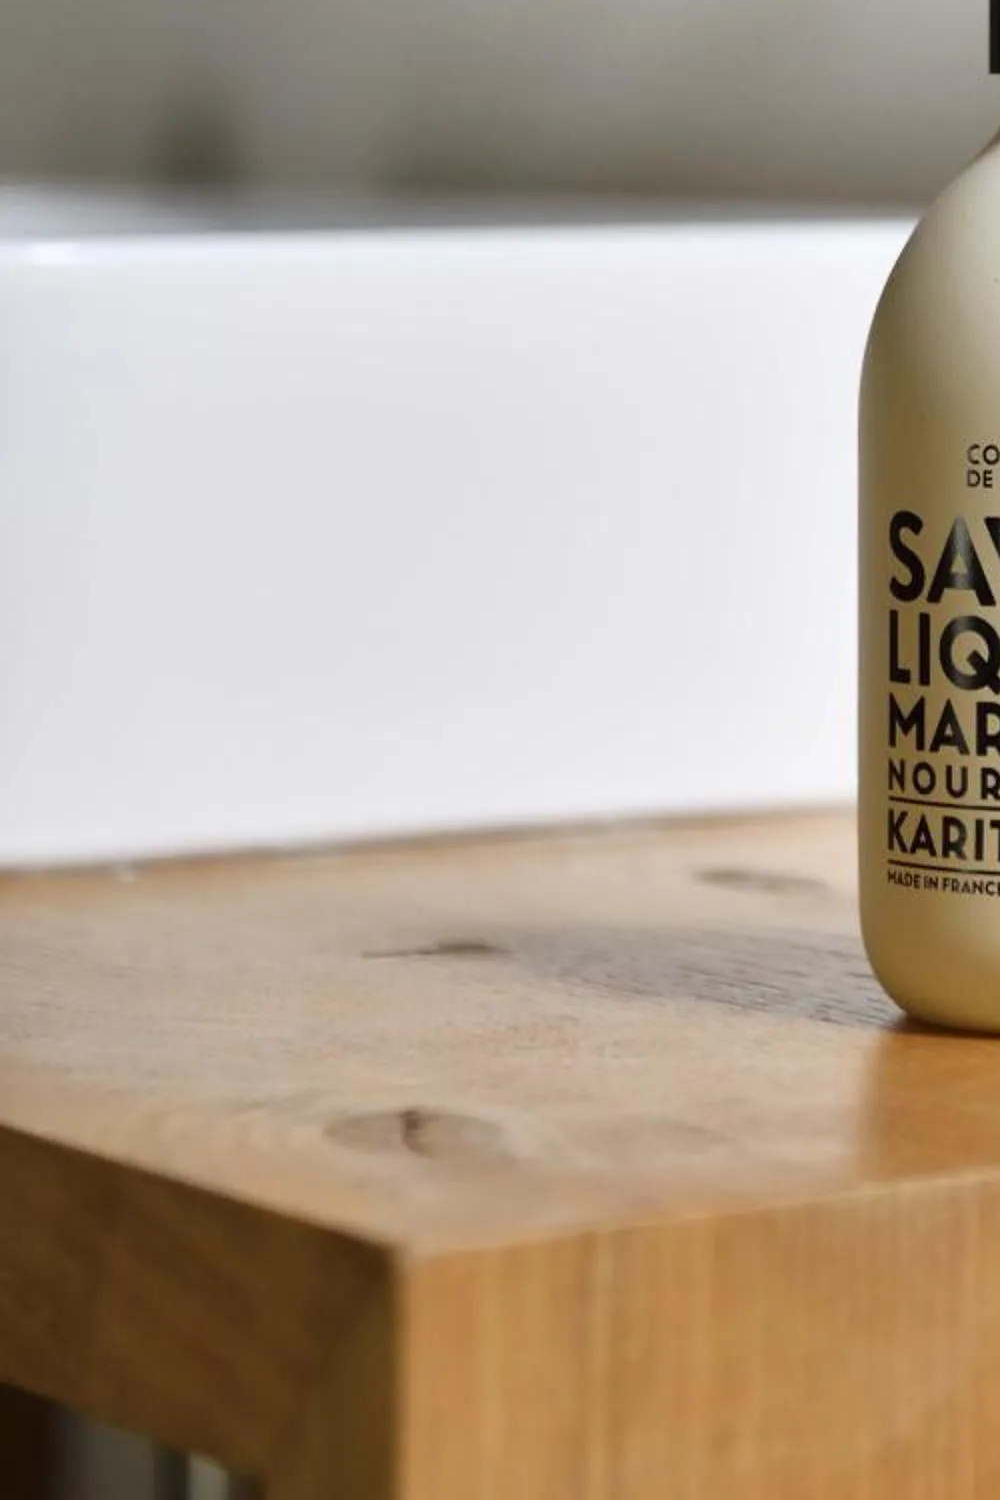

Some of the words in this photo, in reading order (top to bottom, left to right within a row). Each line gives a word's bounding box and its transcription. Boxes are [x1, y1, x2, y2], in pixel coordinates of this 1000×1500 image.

[967, 469, 993, 489] DE
[887, 870, 921, 889] MADE
[923, 875, 939, 891] IN
